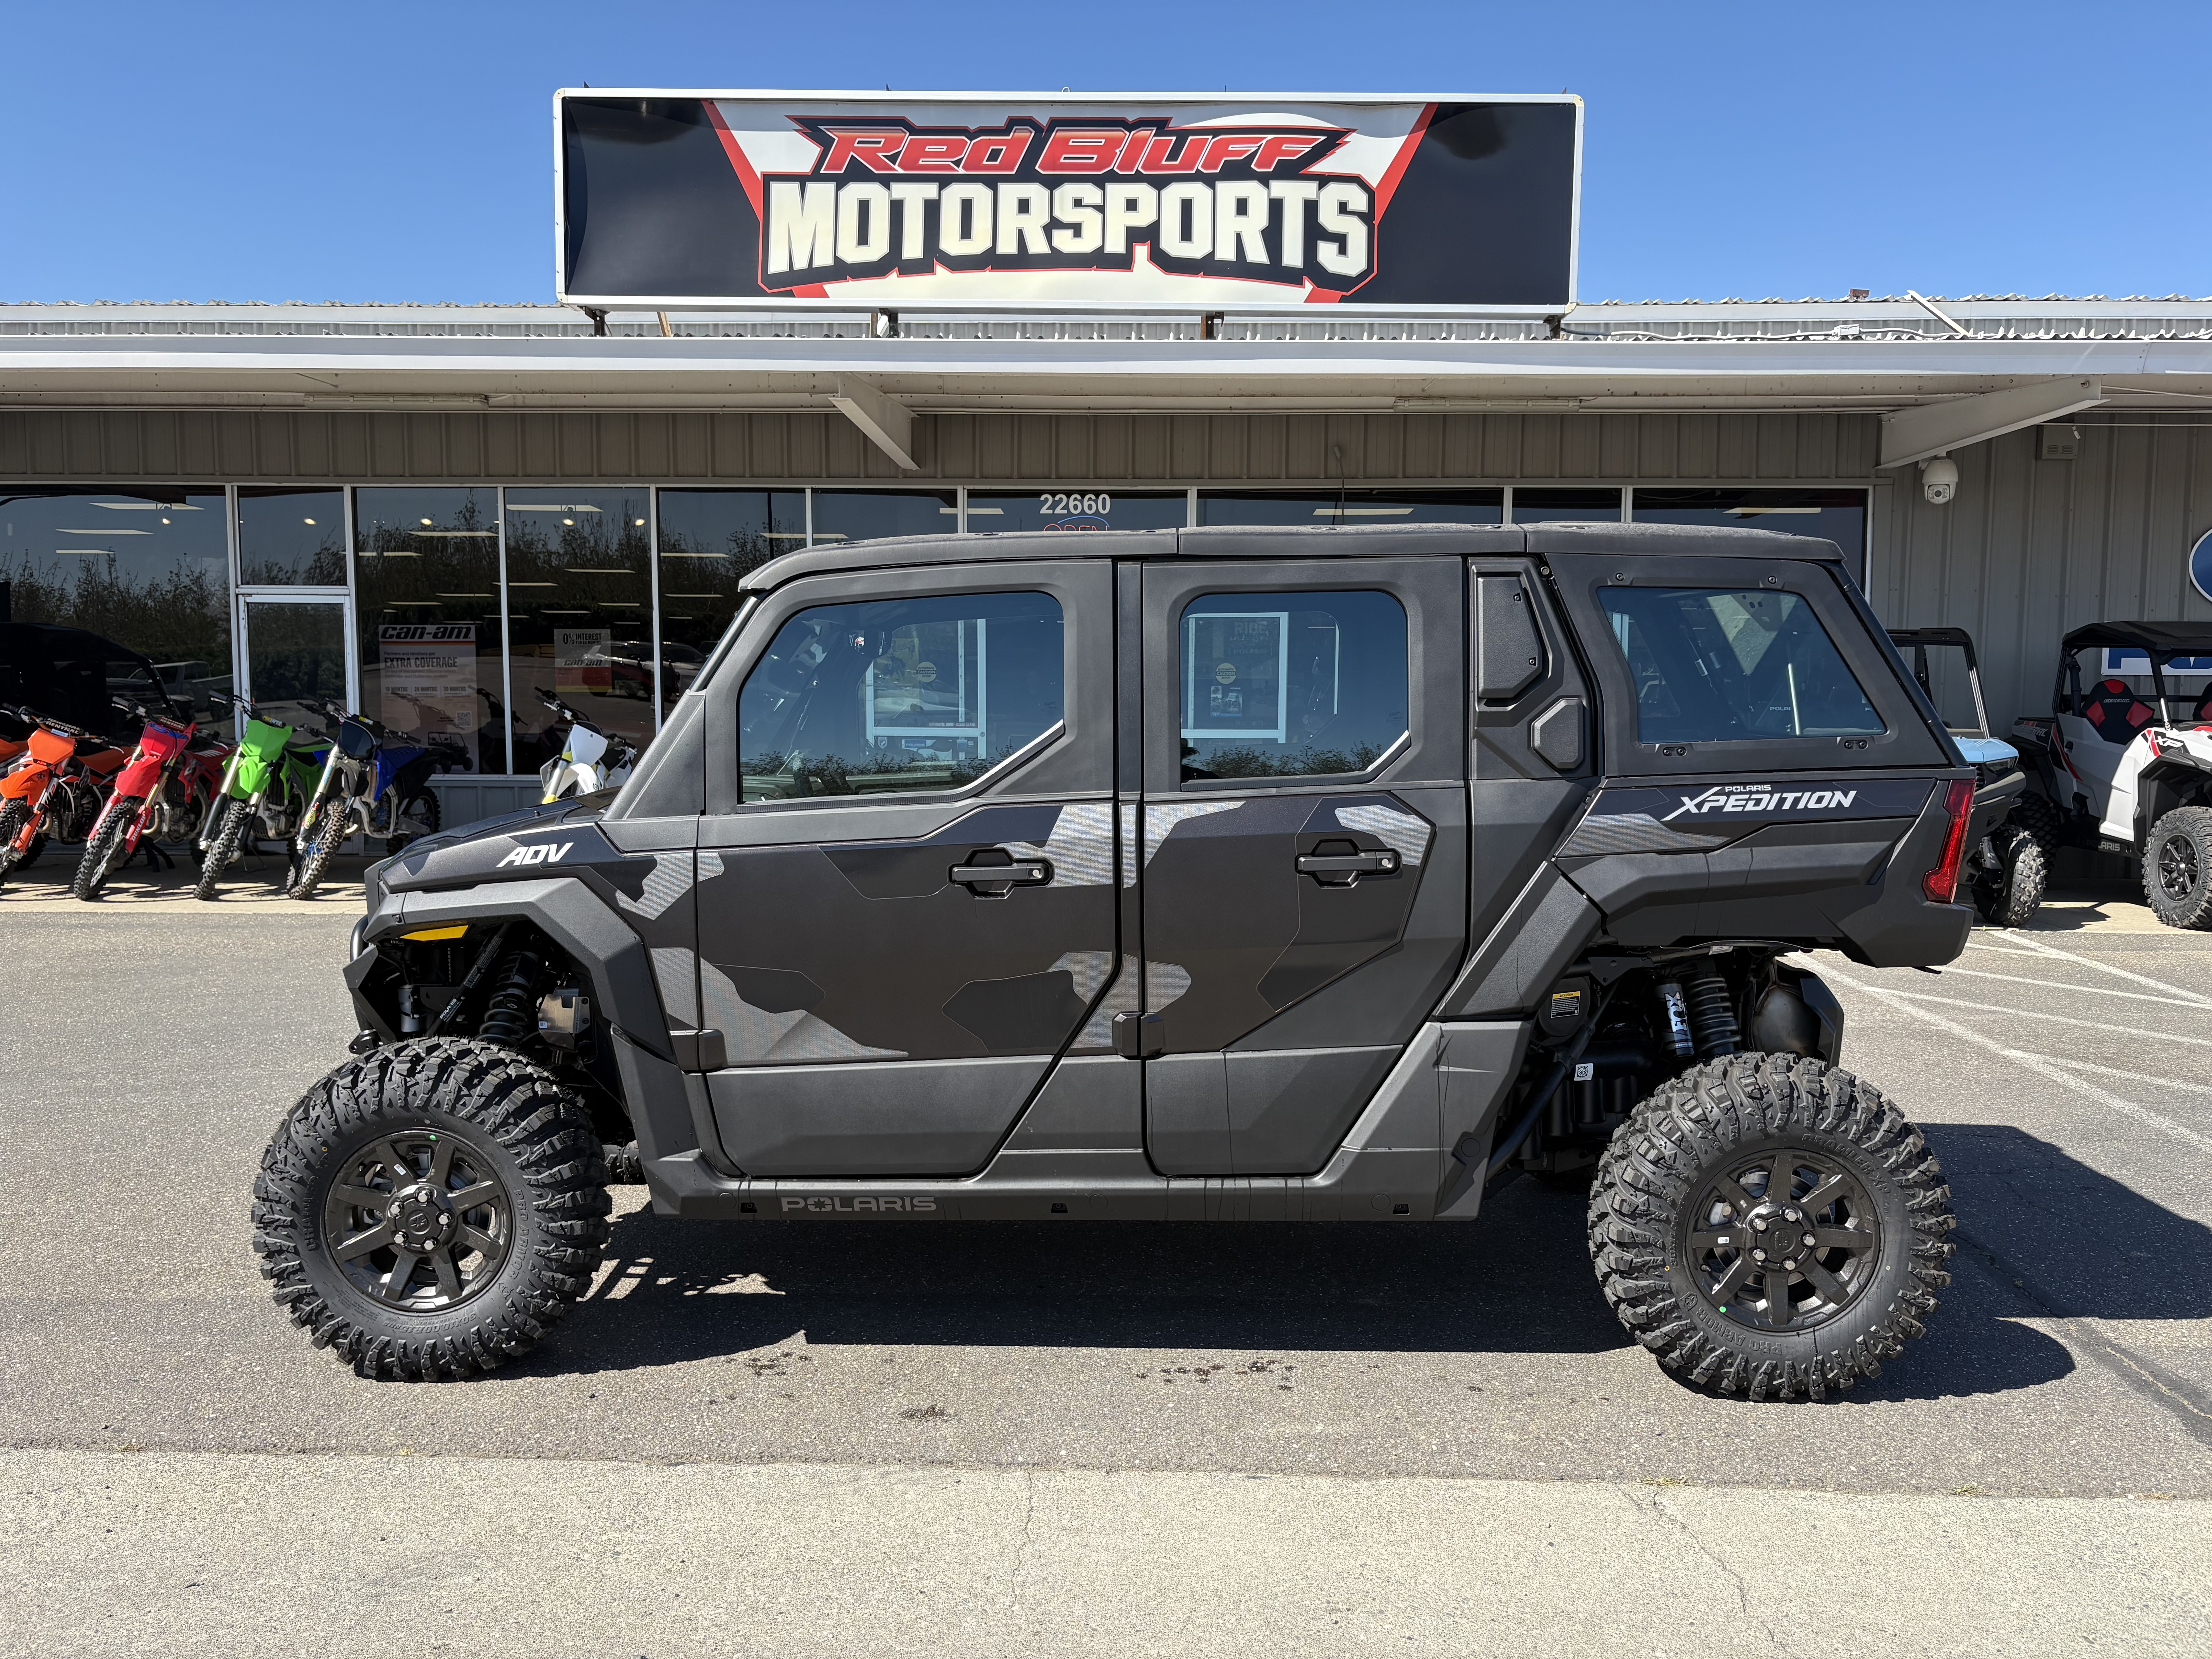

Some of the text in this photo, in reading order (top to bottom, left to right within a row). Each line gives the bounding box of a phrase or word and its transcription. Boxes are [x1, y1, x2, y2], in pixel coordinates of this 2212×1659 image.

[817, 126, 1035, 174] Red
[768, 180, 1369, 276] MOTORSPORTS
[1039, 494, 1111, 514] 22660
[380, 626, 472, 639] can-am
[563, 633, 574, 644] 0%
[384, 657, 457, 668] EXTRA COVERAGE
[2153, 735, 2183, 747] XP
[1661, 786, 1857, 821] XPEDITION
[496, 842, 574, 867] ADV
[440, 998, 457, 1019] POLARIS
[1664, 992, 1688, 1032] FOX
[1802, 1133, 1874, 1175] CRAWLER
[514, 1189, 528, 1221] PRO
[781, 1197, 937, 1212] POLARIS
[1695, 1307, 1782, 1355] PRO ARMOR
